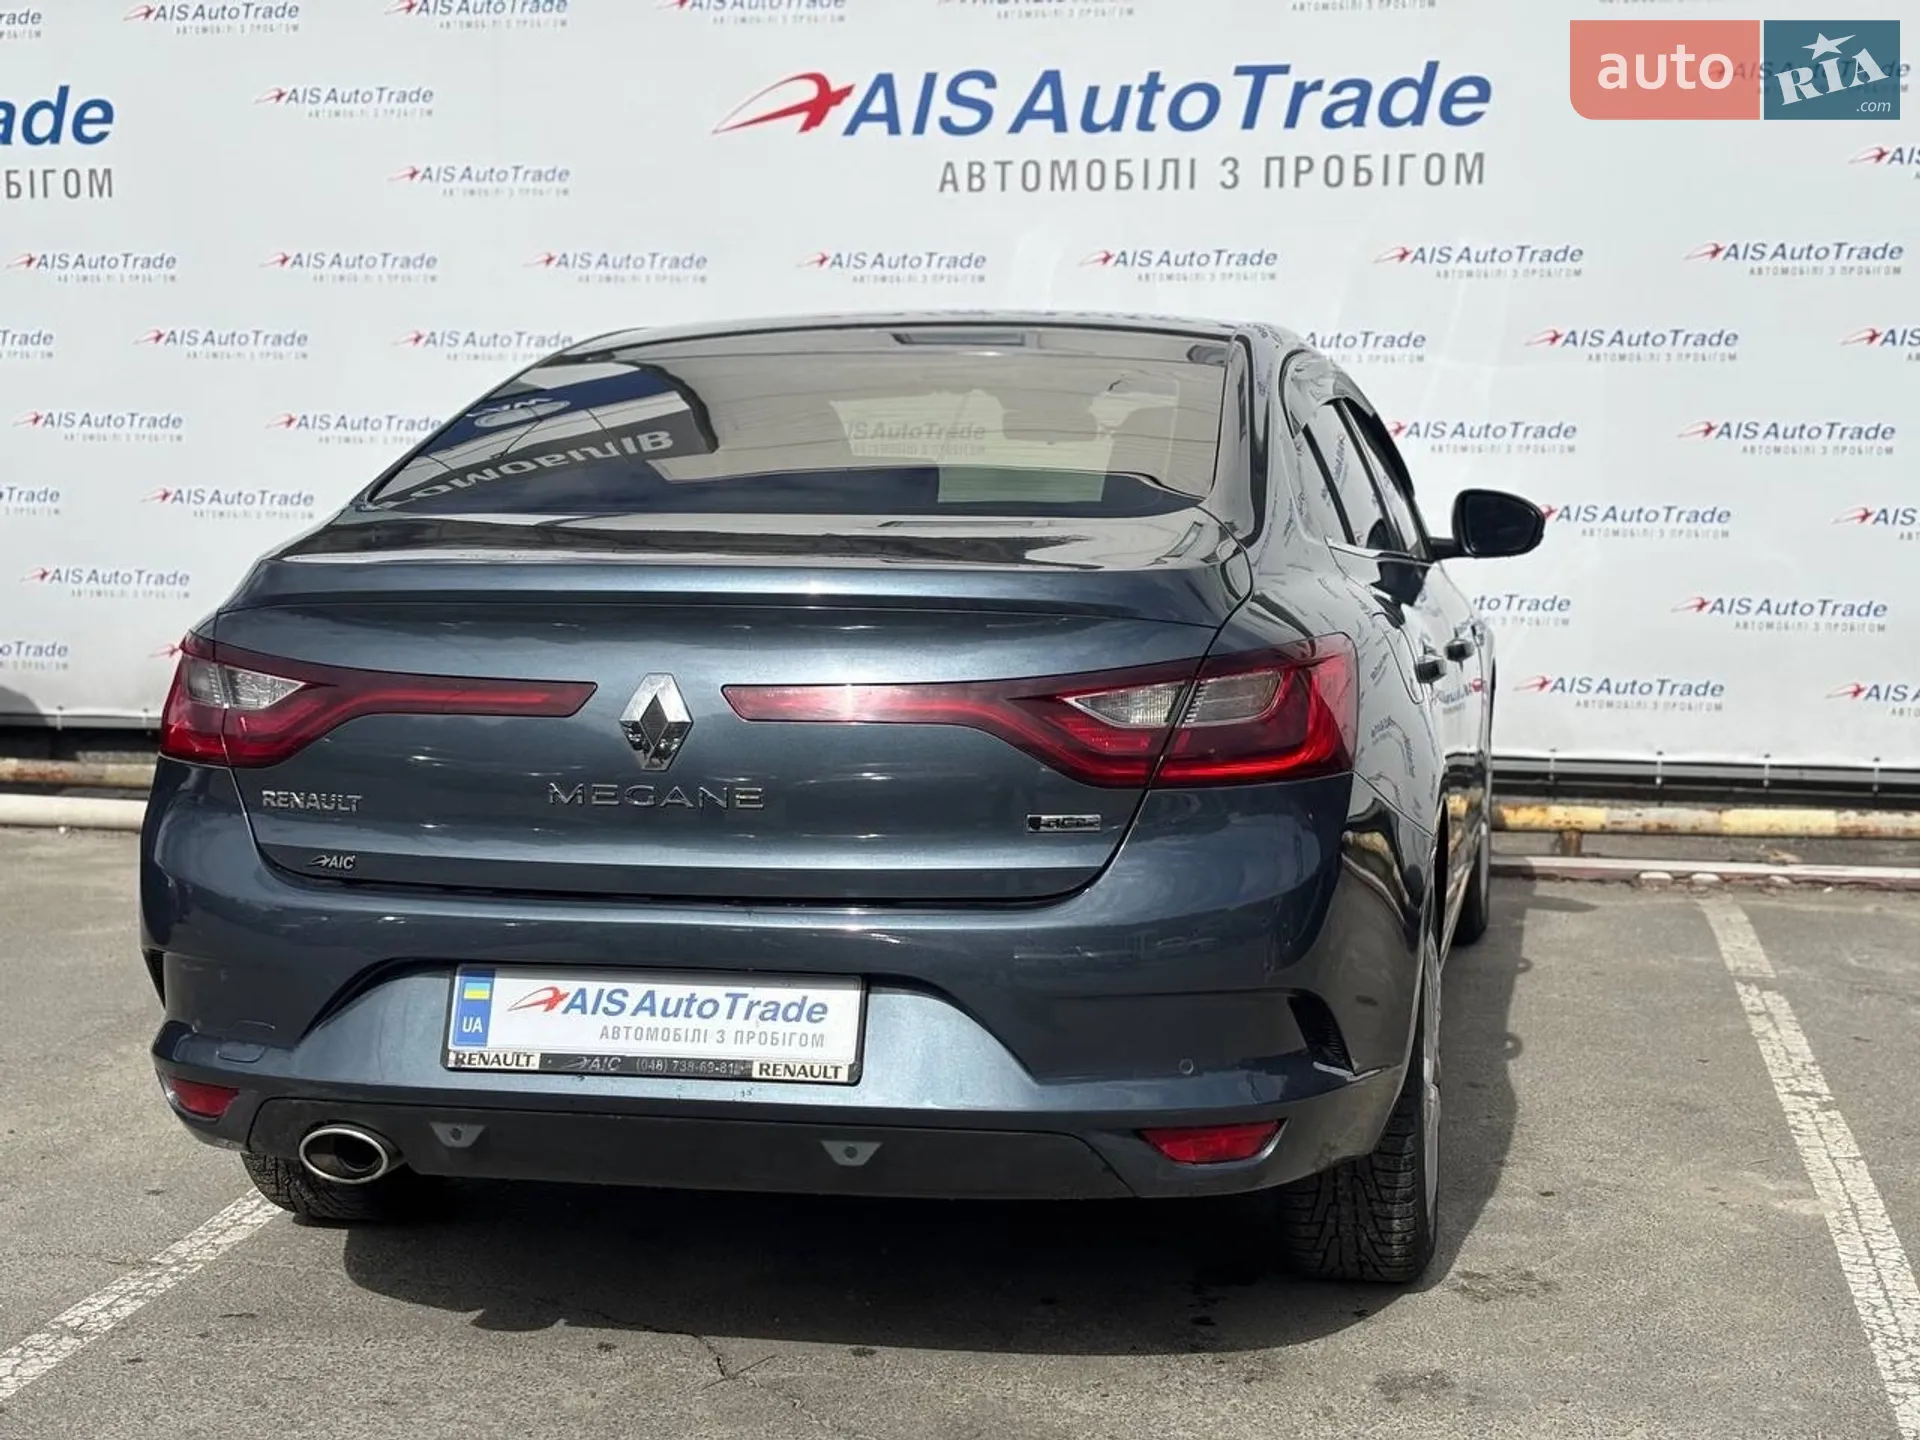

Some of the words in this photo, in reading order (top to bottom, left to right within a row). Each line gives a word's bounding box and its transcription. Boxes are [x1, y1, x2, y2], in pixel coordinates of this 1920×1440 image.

[154, 4, 189, 21] AIS
[192, 2, 299, 20] AutoTrade
[286, 87, 322, 104] AIS
[325, 86, 433, 104] AutoTrade
[842, 70, 997, 136] AIS
[1007, 60, 1492, 134] AutoTrade
[420, 166, 456, 182] AIS
[459, 165, 570, 182] AutoTrade
[938, 158, 1197, 193] АВТОМОБІЛІ
[1219, 157, 1241, 190] З
[1264, 151, 1486, 189] ПРОБІГОМ
[291, 252, 326, 269] AIS
[329, 252, 437, 269] AutoTrade
[556, 252, 593, 269] AIS
[596, 252, 707, 269] AutoTrade
[830, 252, 868, 269] AIS
[871, 251, 986, 269] AutoTrade
[1114, 250, 1154, 267] AIS
[1157, 249, 1277, 267] AutoTrade
[1411, 246, 1453, 264] AIS
[1456, 245, 1584, 264] AutoTrade
[1722, 242, 1766, 261] AIS
[1770, 242, 1905, 261] AutoTrade
[37, 253, 71, 269] AIS
[73, 253, 176, 269] AutoTrade
[164, 330, 199, 346] AIS
[202, 329, 308, 346] AutoTrade
[425, 331, 461, 347] AIS
[1562, 329, 1605, 348] AIS
[1608, 329, 1739, 347] AutoTrade
[43, 412, 77, 428] AIS
[80, 412, 183, 429] AutoTrade
[1405, 421, 1447, 439] AIS
[1450, 421, 1577, 439] AutoTrade
[1716, 421, 1759, 439] AIS
[1763, 422, 1895, 440] AutoTrade
[171, 488, 206, 505] AIS
[208, 489, 314, 505] AutoTrade
[1556, 505, 1599, 523] AIS
[1602, 505, 1731, 523] AutoTrade
[1873, 508, 1916, 526] AIS
[51, 568, 85, 584] AIS
[87, 569, 190, 585] AutoTrade
[1709, 597, 1752, 615] AIS
[1756, 598, 1888, 617] AutoTrade
[1550, 676, 1592, 694] AIS
[1596, 677, 1724, 697] AutoTrade
[1865, 684, 1908, 702] AIS
[261, 790, 363, 813] RENAULT
[549, 782, 764, 809] MEGANE
[562, 987, 629, 1016] AIS
[631, 989, 829, 1024] AutoTrade
[463, 1016, 483, 1033] UA
[600, 1025, 708, 1044] АВТОМОБІЛІ
[716, 1030, 726, 1044] З
[734, 1030, 825, 1048] ПРОБІГОМ
[454, 1053, 535, 1068] RENAULT
[758, 1064, 843, 1080] RENAULT
